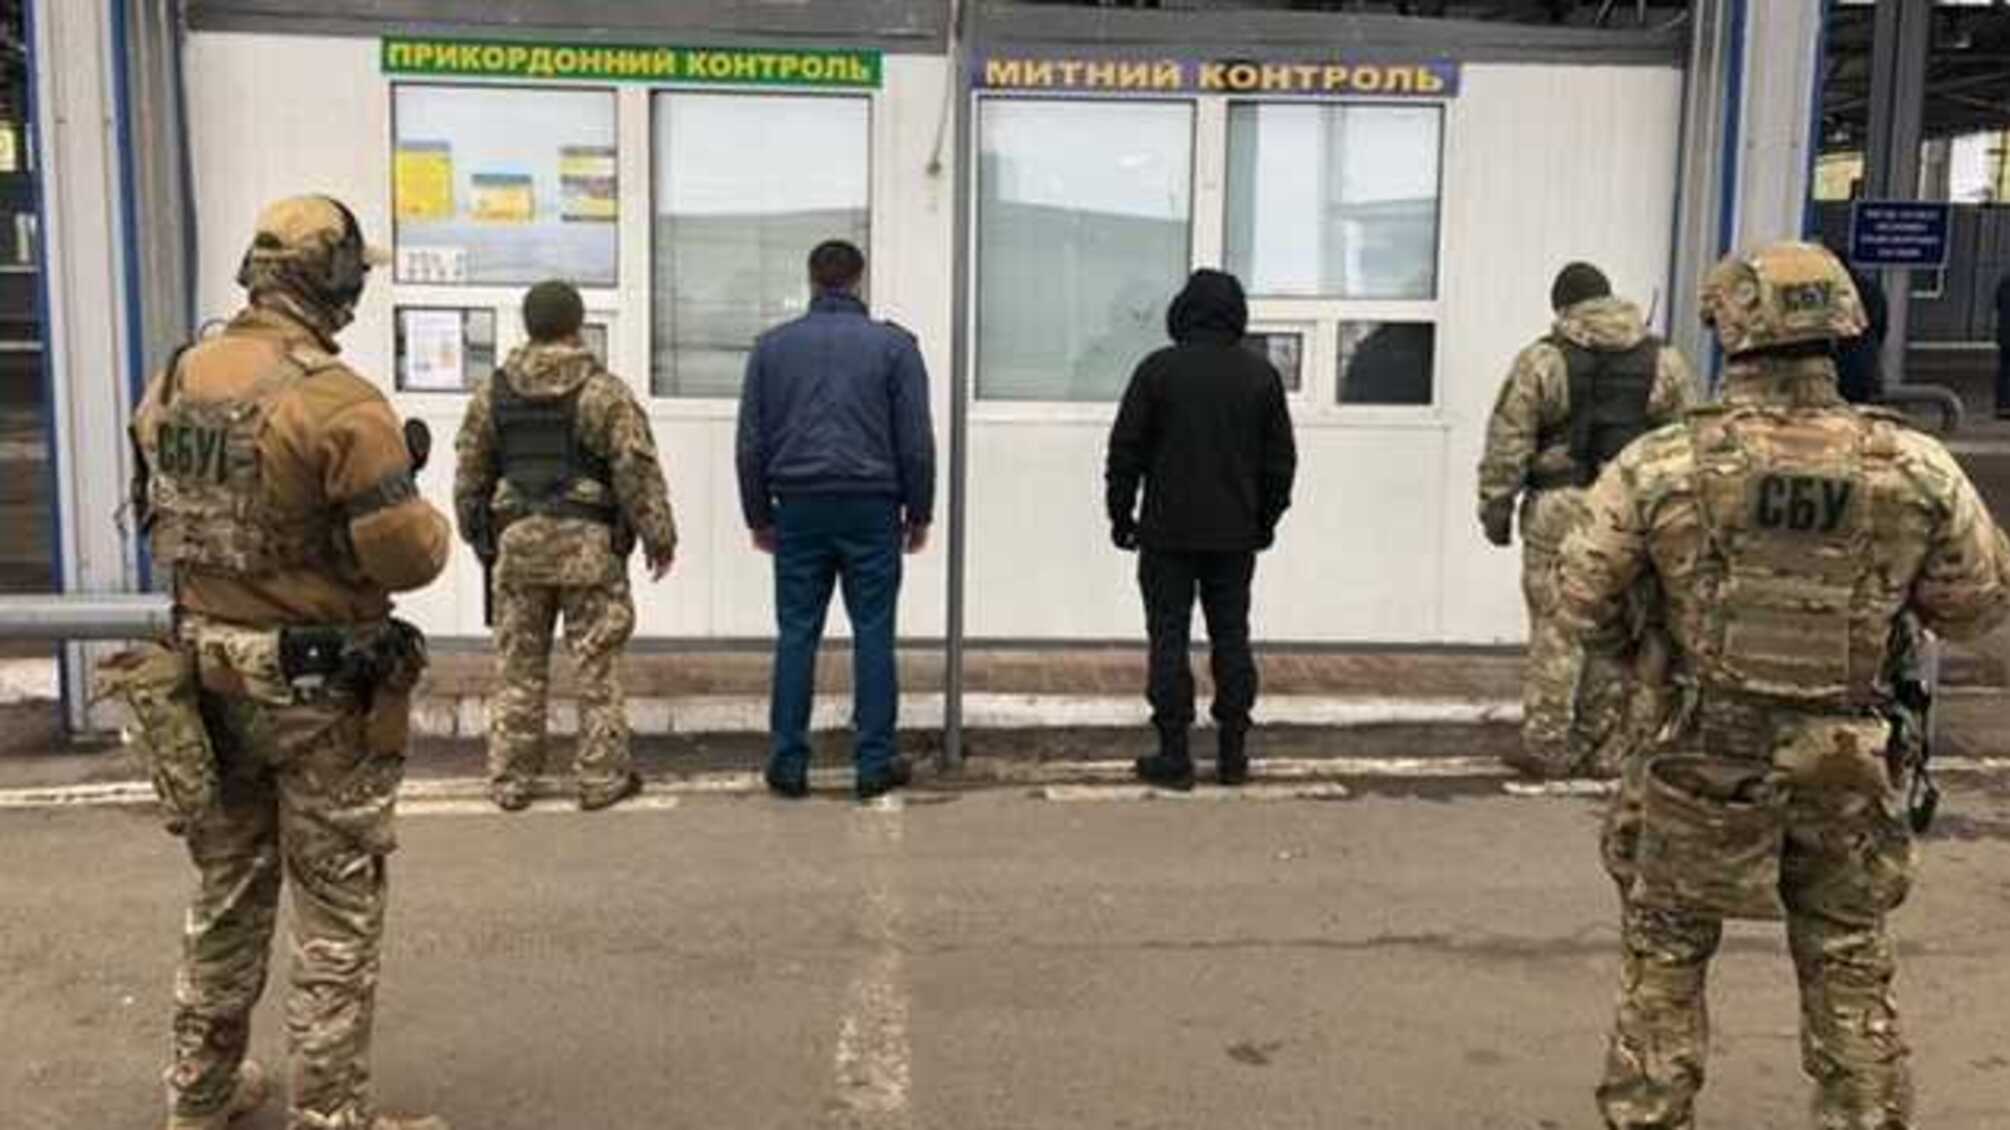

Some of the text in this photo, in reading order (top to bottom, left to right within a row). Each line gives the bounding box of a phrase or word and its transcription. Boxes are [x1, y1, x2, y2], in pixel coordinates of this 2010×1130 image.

[387, 42, 868, 80] ПРИКОРДОННИЙ КОНТРОЛЬ
[984, 58, 1445, 93] МИТНИЙ КОНТРОЛЬ
[1757, 474, 1856, 532] СБУ
